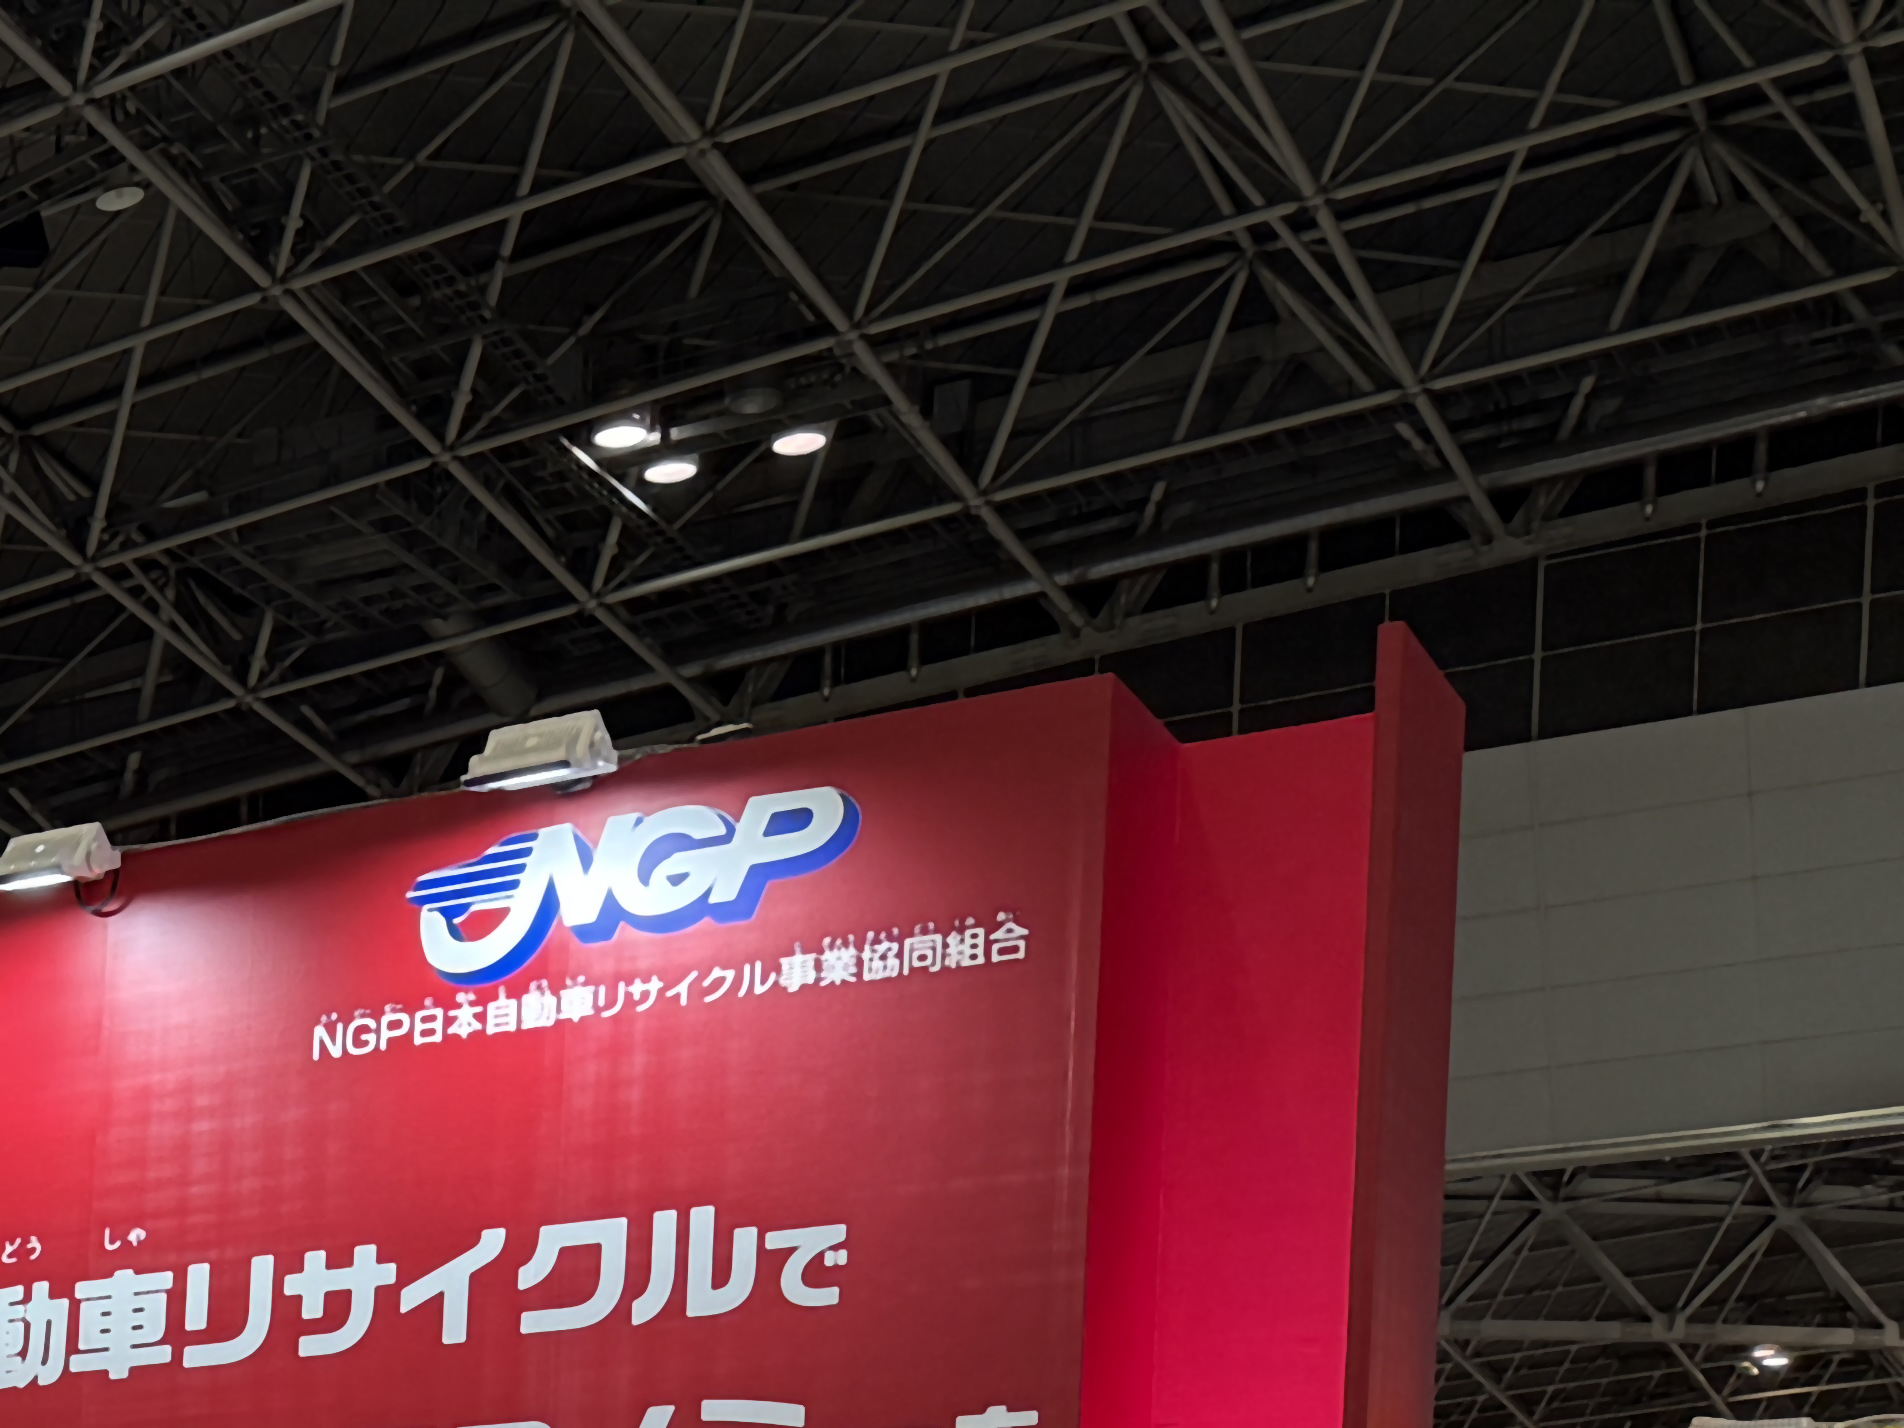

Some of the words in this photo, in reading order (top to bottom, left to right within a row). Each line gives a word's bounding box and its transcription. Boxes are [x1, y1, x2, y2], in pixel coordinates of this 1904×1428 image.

[407, 786, 860, 987] NGP
[312, 921, 1030, 1061] NGP日本自動車リサイクル事業協同組合
[0, 1235, 42, 1264] どう
